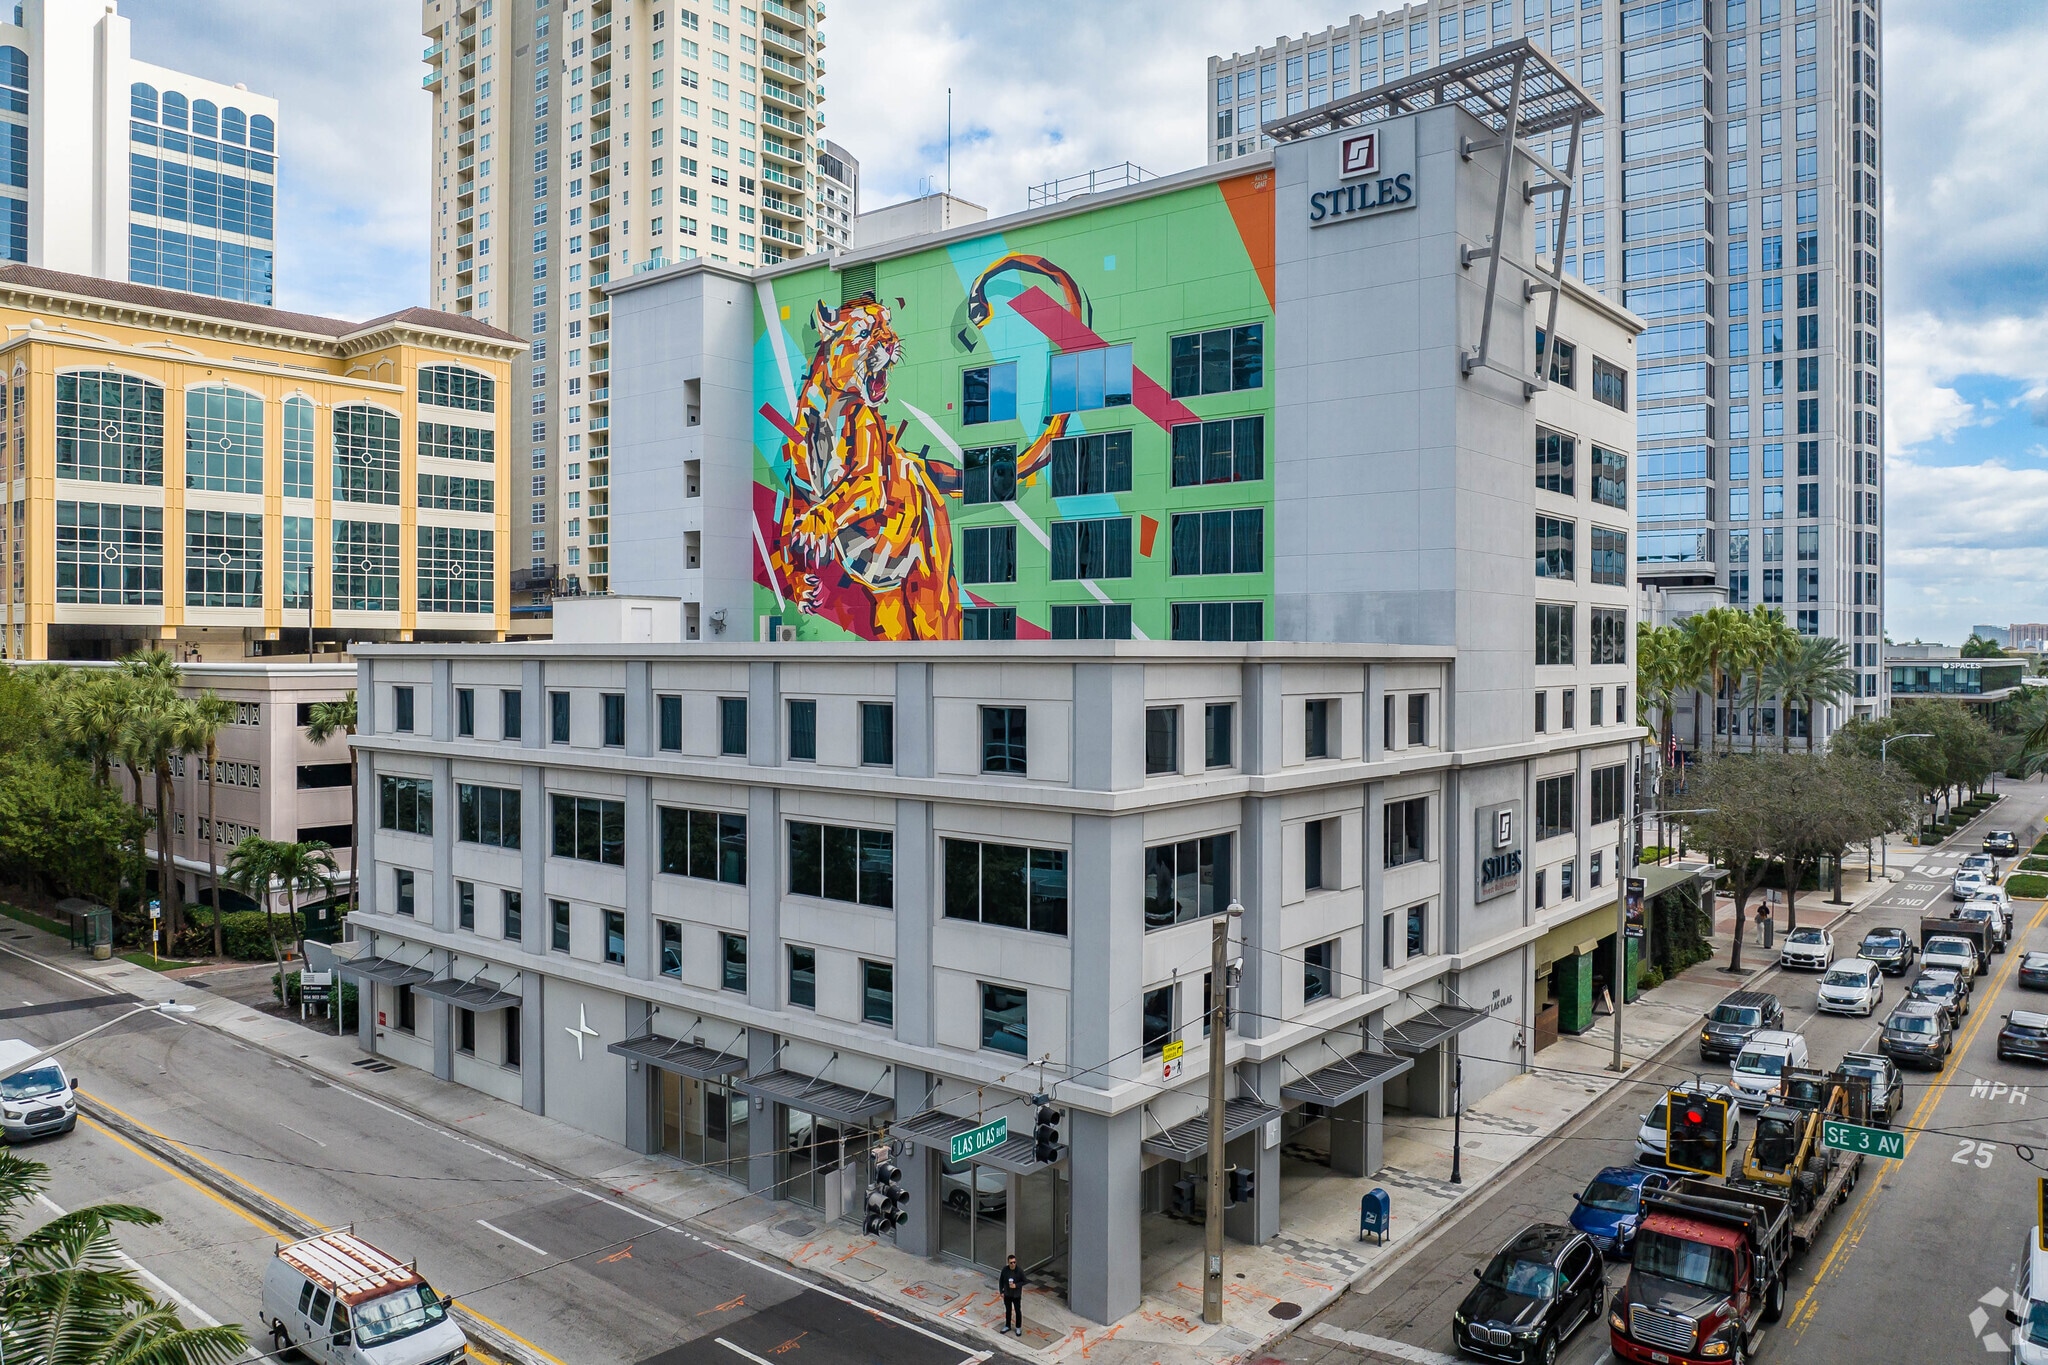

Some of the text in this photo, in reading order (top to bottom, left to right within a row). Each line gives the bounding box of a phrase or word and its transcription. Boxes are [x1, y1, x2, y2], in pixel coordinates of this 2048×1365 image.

[1310, 173, 1412, 221] STILES
[1481, 850, 1522, 883] STILES
[1904, 883, 1935, 891] BUS
[1882, 897, 1925, 906] ONLY
[1969, 1078, 2030, 1105] MPH
[953, 1125, 1006, 1155] E LAS OLAS BLVD
[1828, 1127, 1900, 1154] SE 3 AV
[1951, 1140, 1997, 1169] 25
